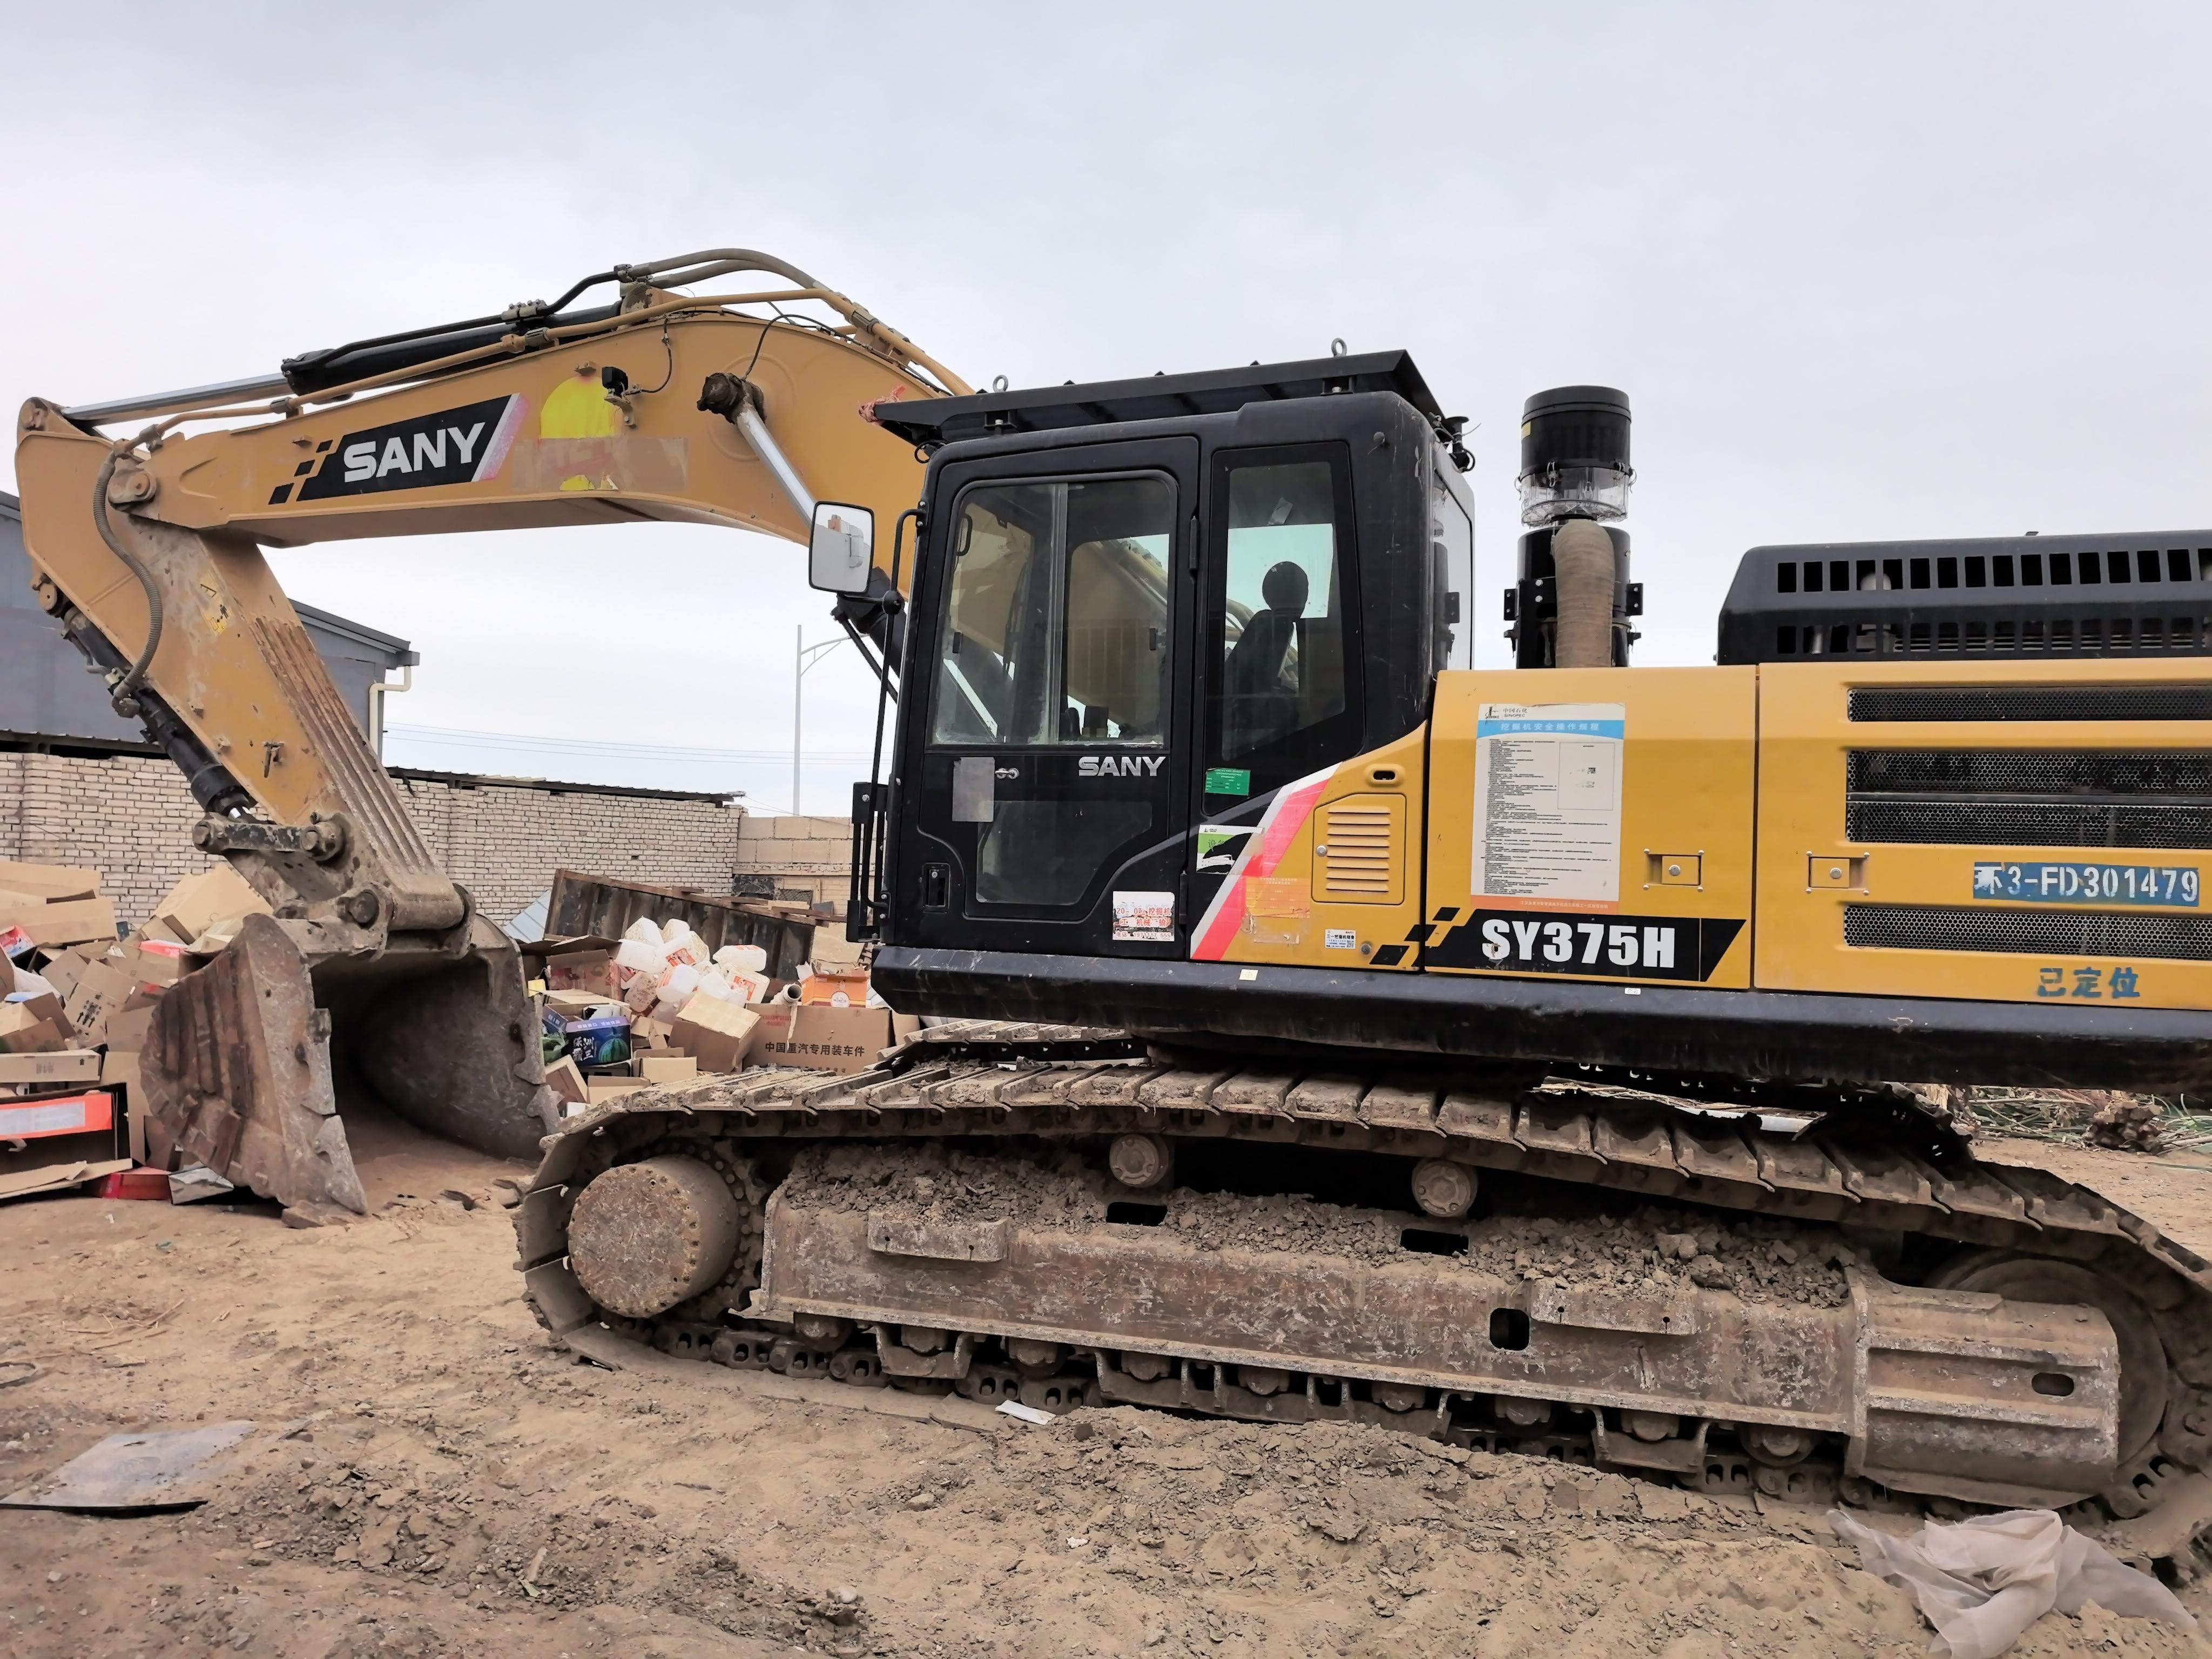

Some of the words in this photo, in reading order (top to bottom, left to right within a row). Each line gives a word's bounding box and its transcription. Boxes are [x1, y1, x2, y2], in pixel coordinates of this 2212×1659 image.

[343, 422, 485, 483] SANY
[1078, 756, 1166, 777] SANY
[1482, 919, 1675, 968] SY375H
[765, 1041, 865, 1057] 中国重汽专用装车件
